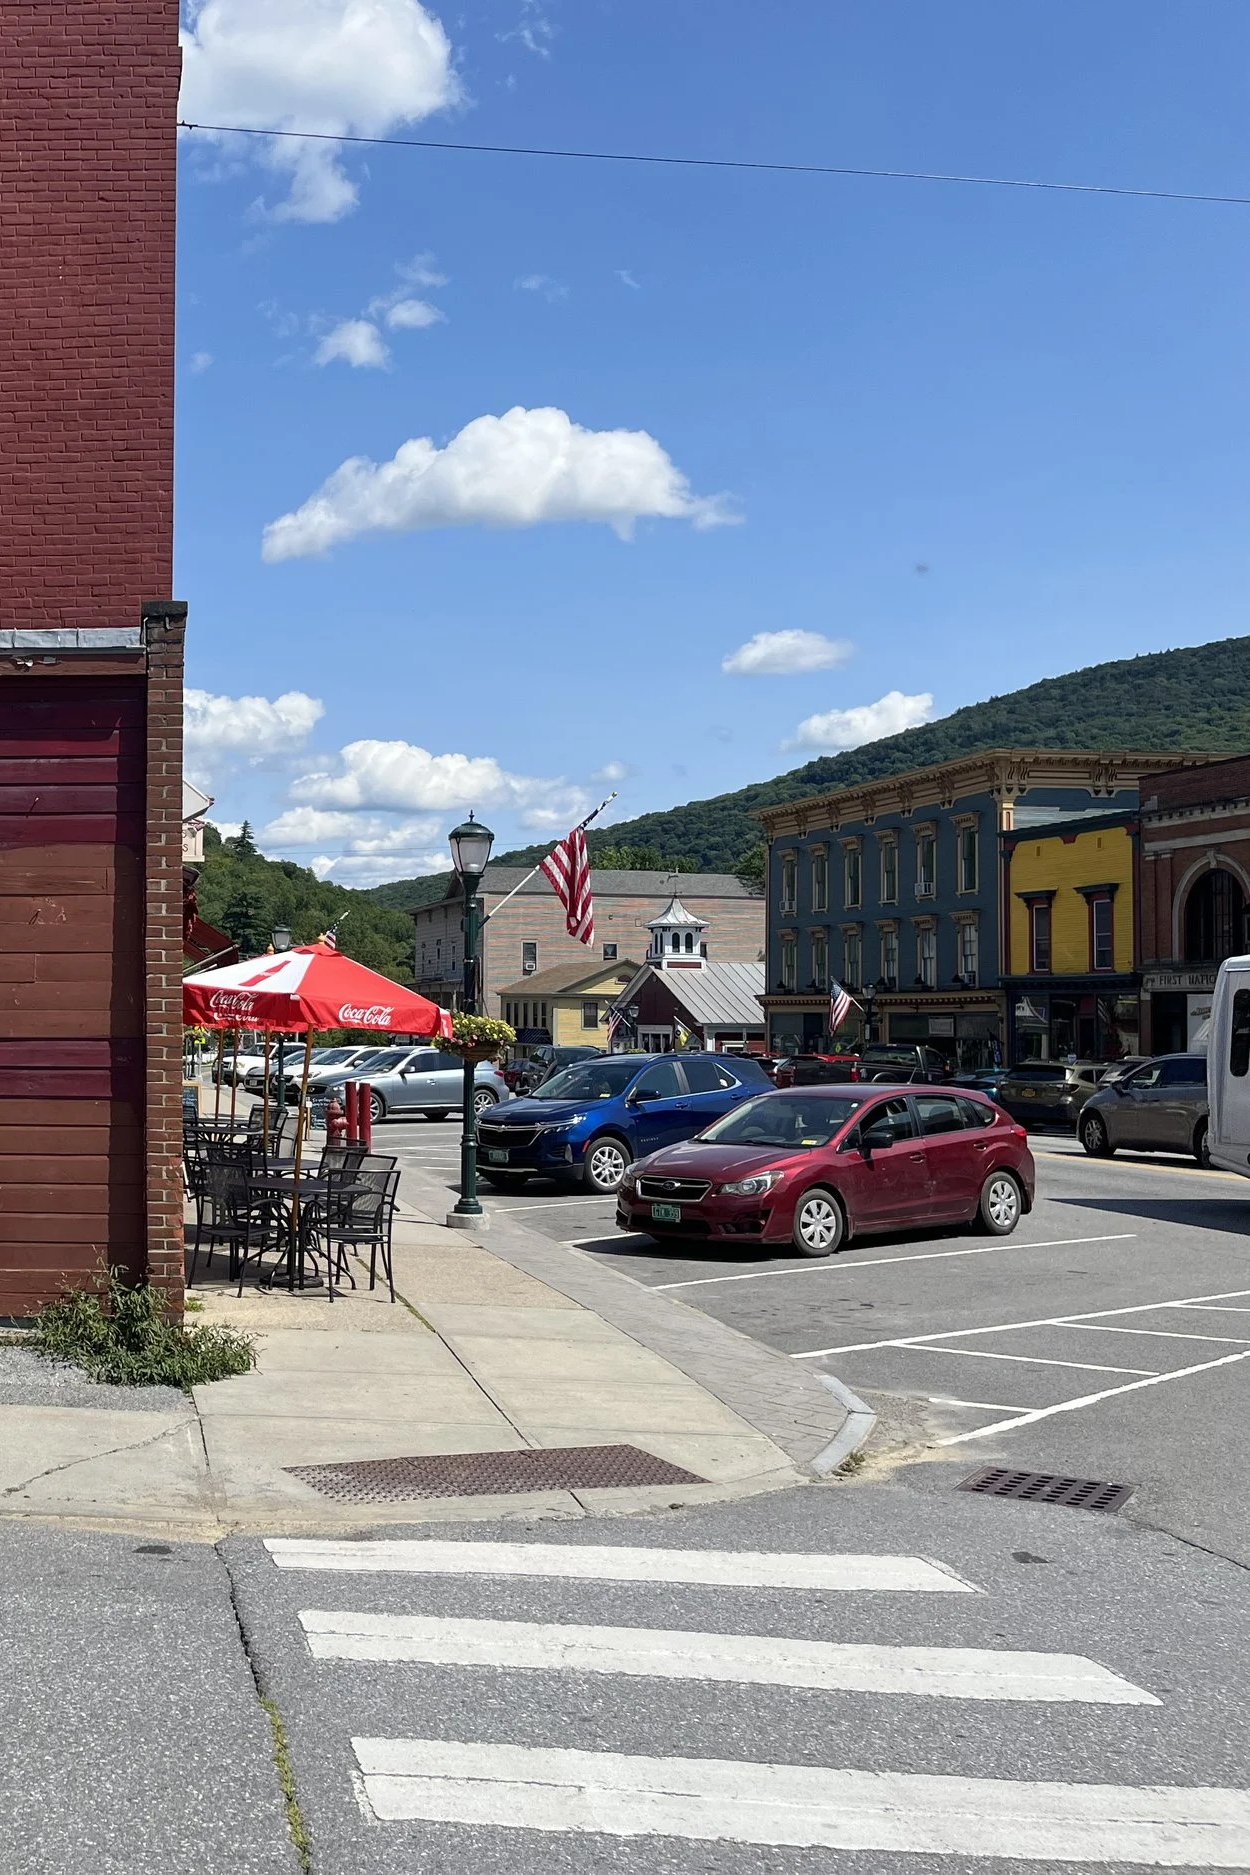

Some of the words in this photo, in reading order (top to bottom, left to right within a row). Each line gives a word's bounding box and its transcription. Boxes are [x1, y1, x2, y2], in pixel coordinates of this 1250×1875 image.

[1159, 975, 1182, 985] FIRST
[1188, 975, 1216, 985] NATIO
[338, 1003, 394, 1025] Coca-Cola
